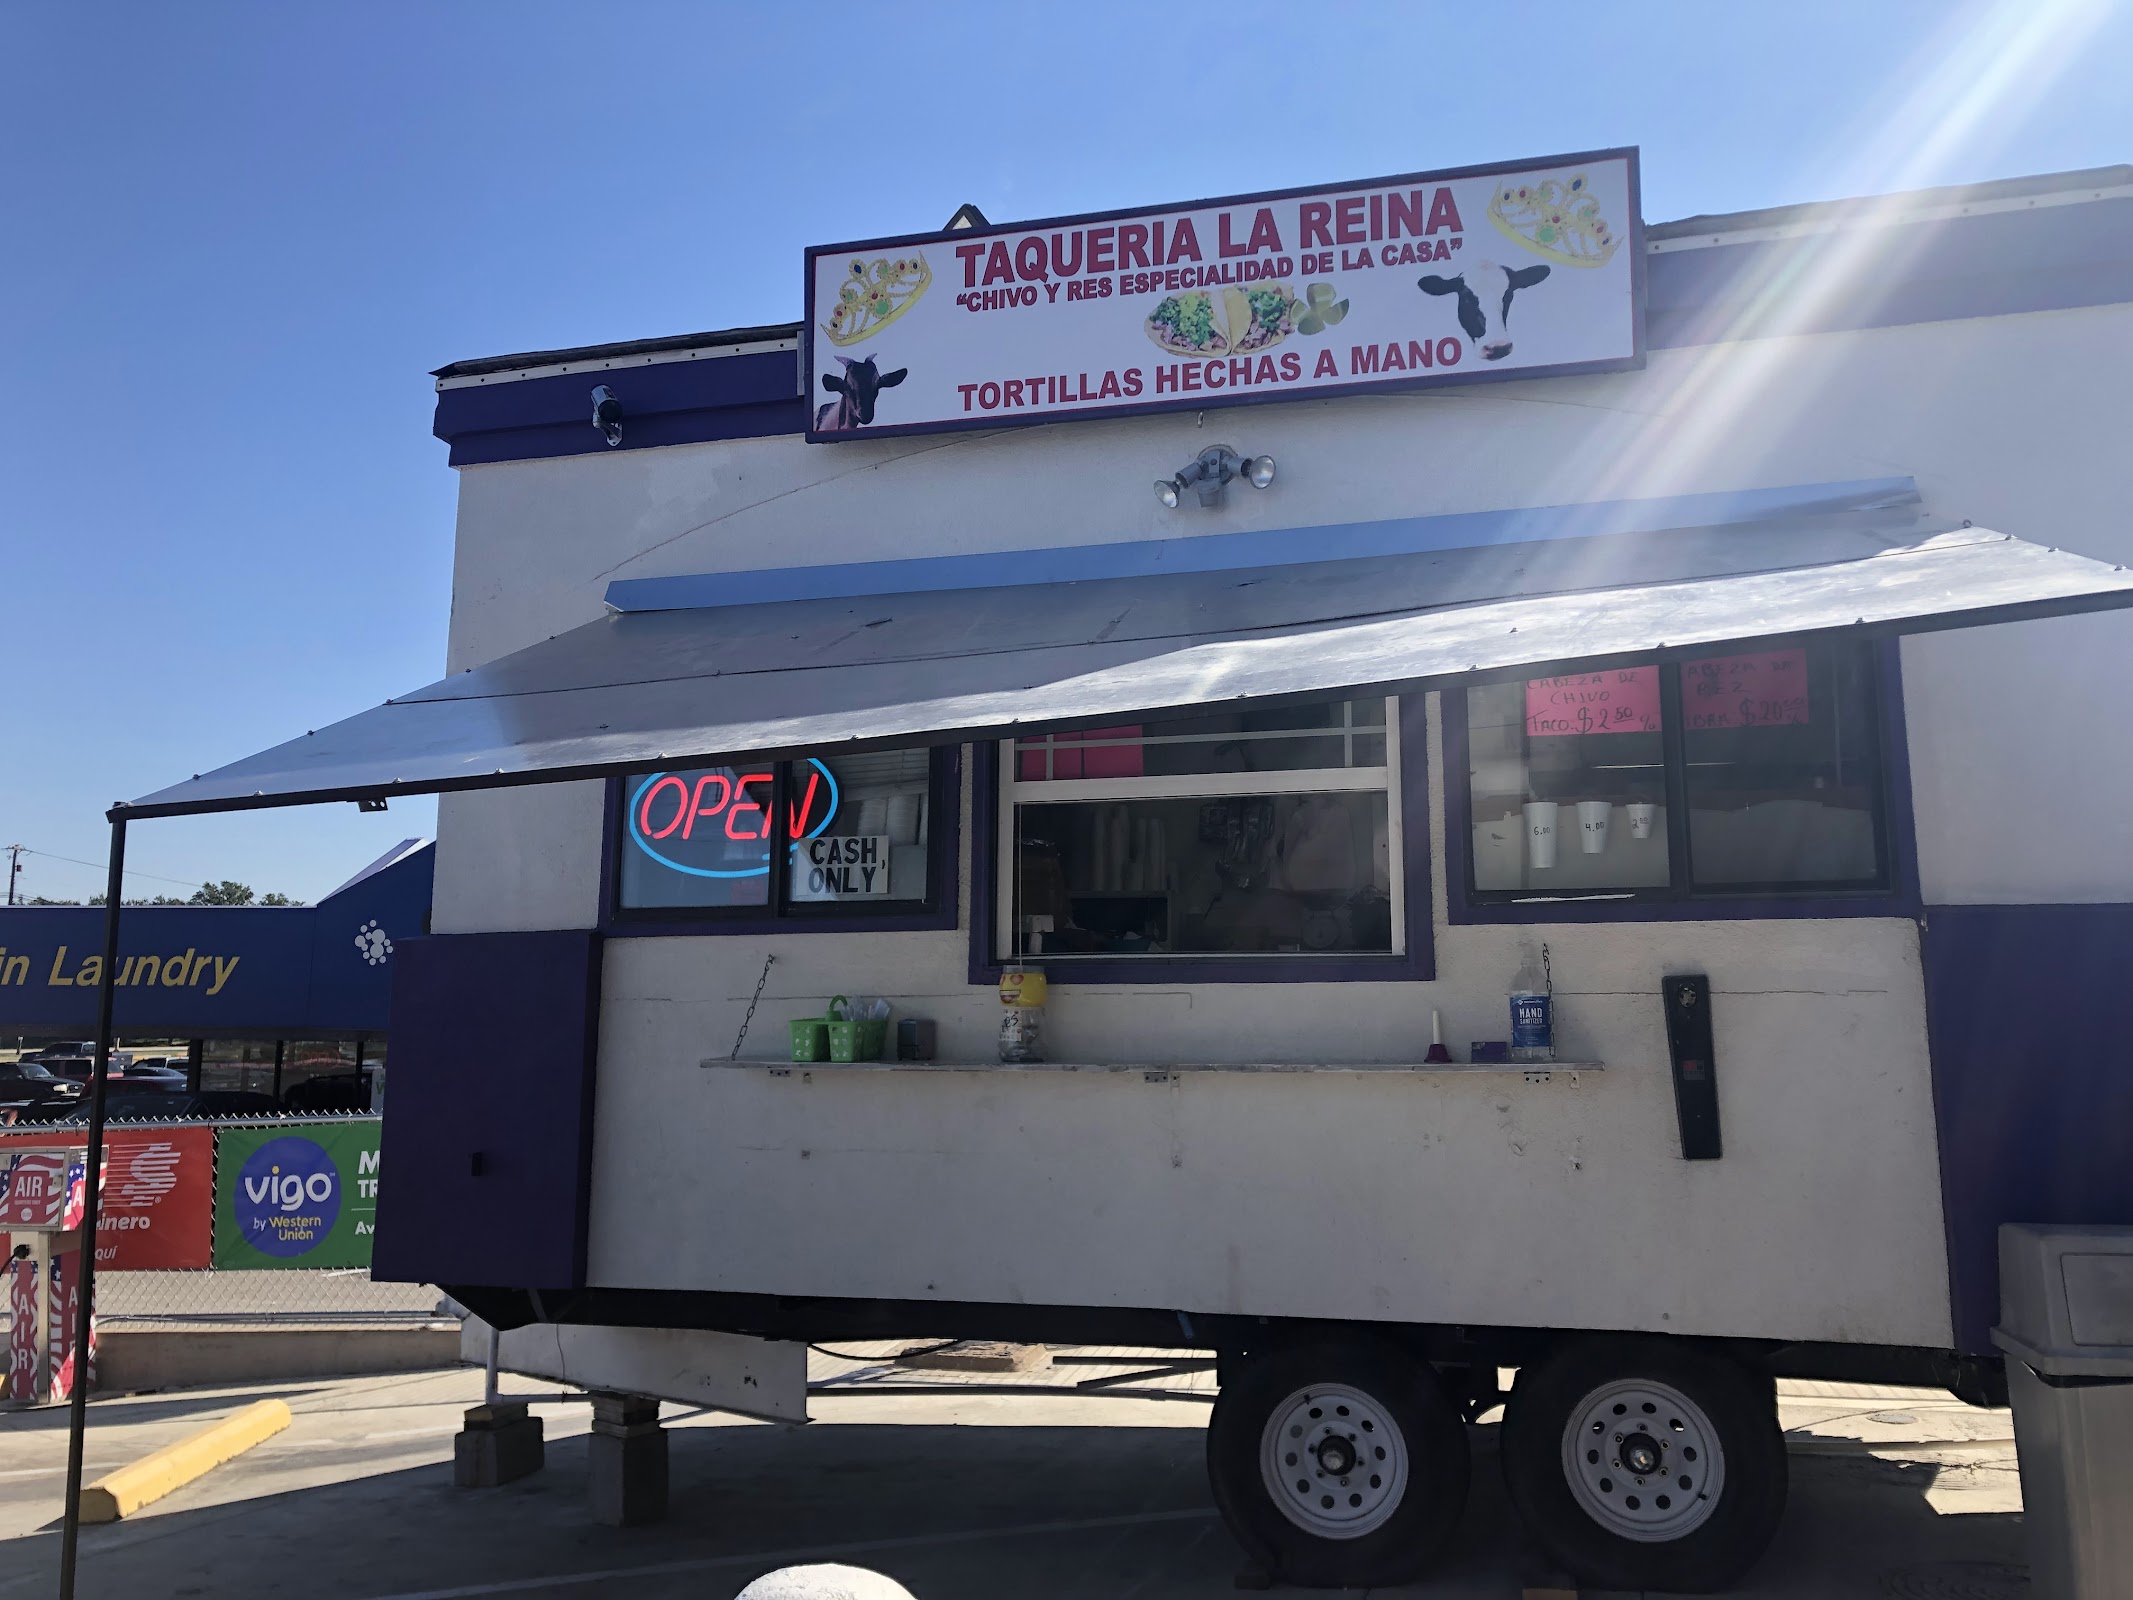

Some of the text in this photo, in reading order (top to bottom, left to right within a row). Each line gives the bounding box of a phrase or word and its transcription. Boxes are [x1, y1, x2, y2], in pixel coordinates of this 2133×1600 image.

[956, 187, 1464, 288] TAQUERIA LA REINA
[1044, 282, 1060, 303] Y
[1067, 278, 1112, 301] RES
[1120, 257, 1293, 295] ESPECIALIDAD
[1301, 252, 1334, 275] DE
[1342, 248, 1374, 270] LA
[958, 336, 1462, 411] TORTILLAS HECHAS A MANO
[1526, 674, 1602, 690] CABEZA
[1550, 691, 1610, 705] CHIVO
[640, 773, 819, 840] OPEN
[1533, 826, 1550, 836] 6.00
[1585, 821, 1605, 832] 4.00
[810, 838, 877, 865] CASH
[808, 866, 877, 894] ONLY
[0, 945, 241, 995] n Laundry
[1519, 1007, 1543, 1018] HAND
[14, 1175, 43, 1198] AIR
[245, 1166, 332, 1212] vigo
[97, 1212, 151, 1231] inero
[253, 1216, 321, 1231] by Western
[278, 1228, 314, 1241] Union
